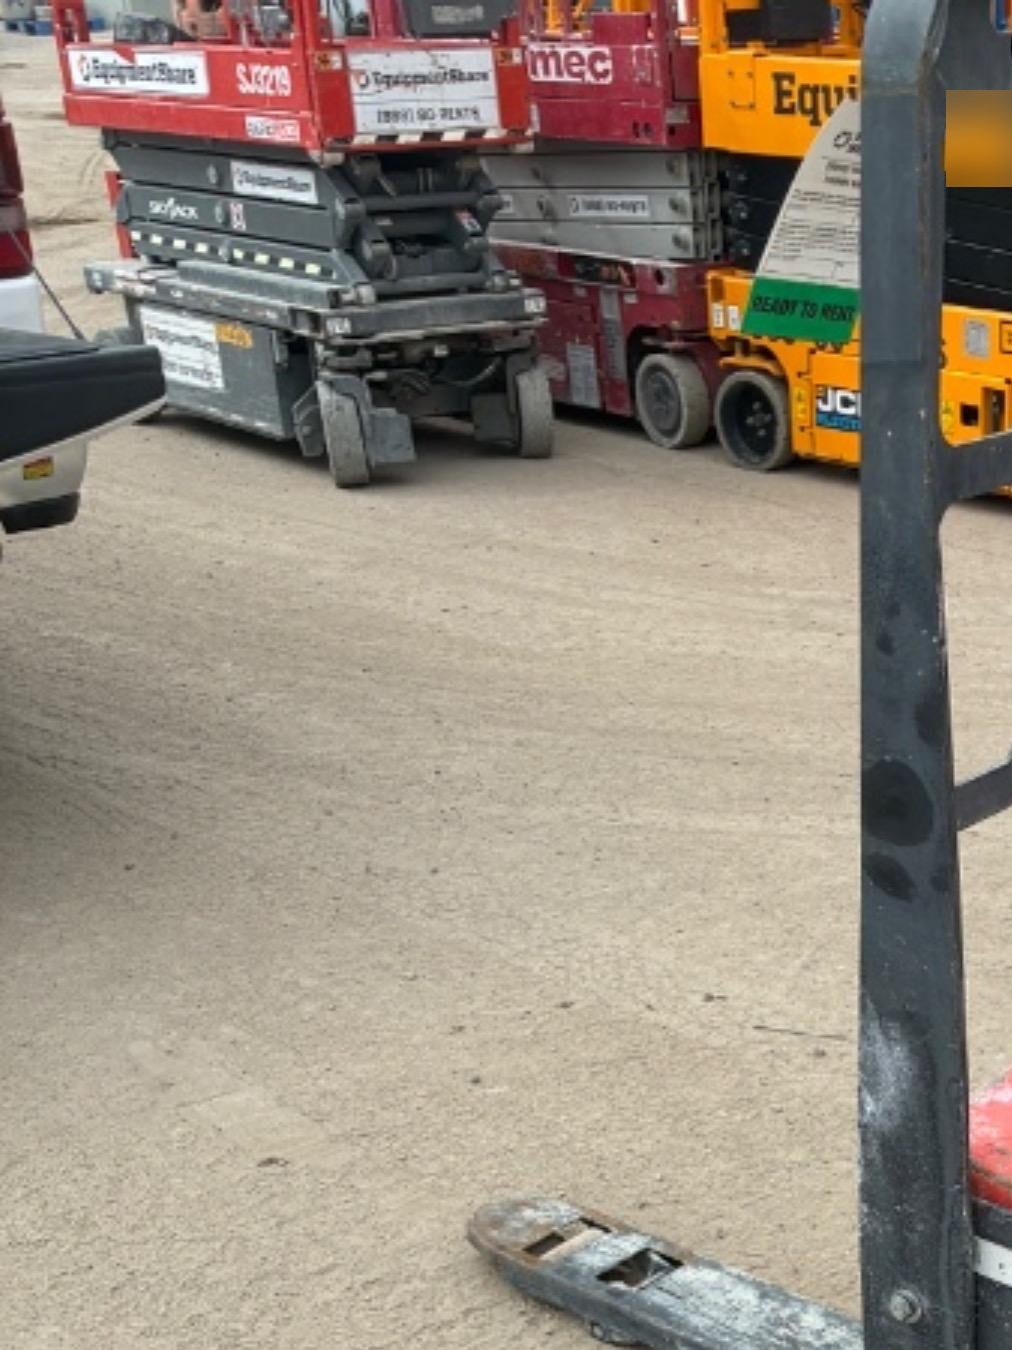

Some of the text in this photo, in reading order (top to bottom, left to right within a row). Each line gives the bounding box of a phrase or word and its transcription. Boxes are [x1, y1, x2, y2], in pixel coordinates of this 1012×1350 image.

[235, 62, 292, 96] SJ3219
[529, 49, 612, 82] mec
[753, 296, 857, 322] READY TO RENT
[817, 386, 863, 418] JC
